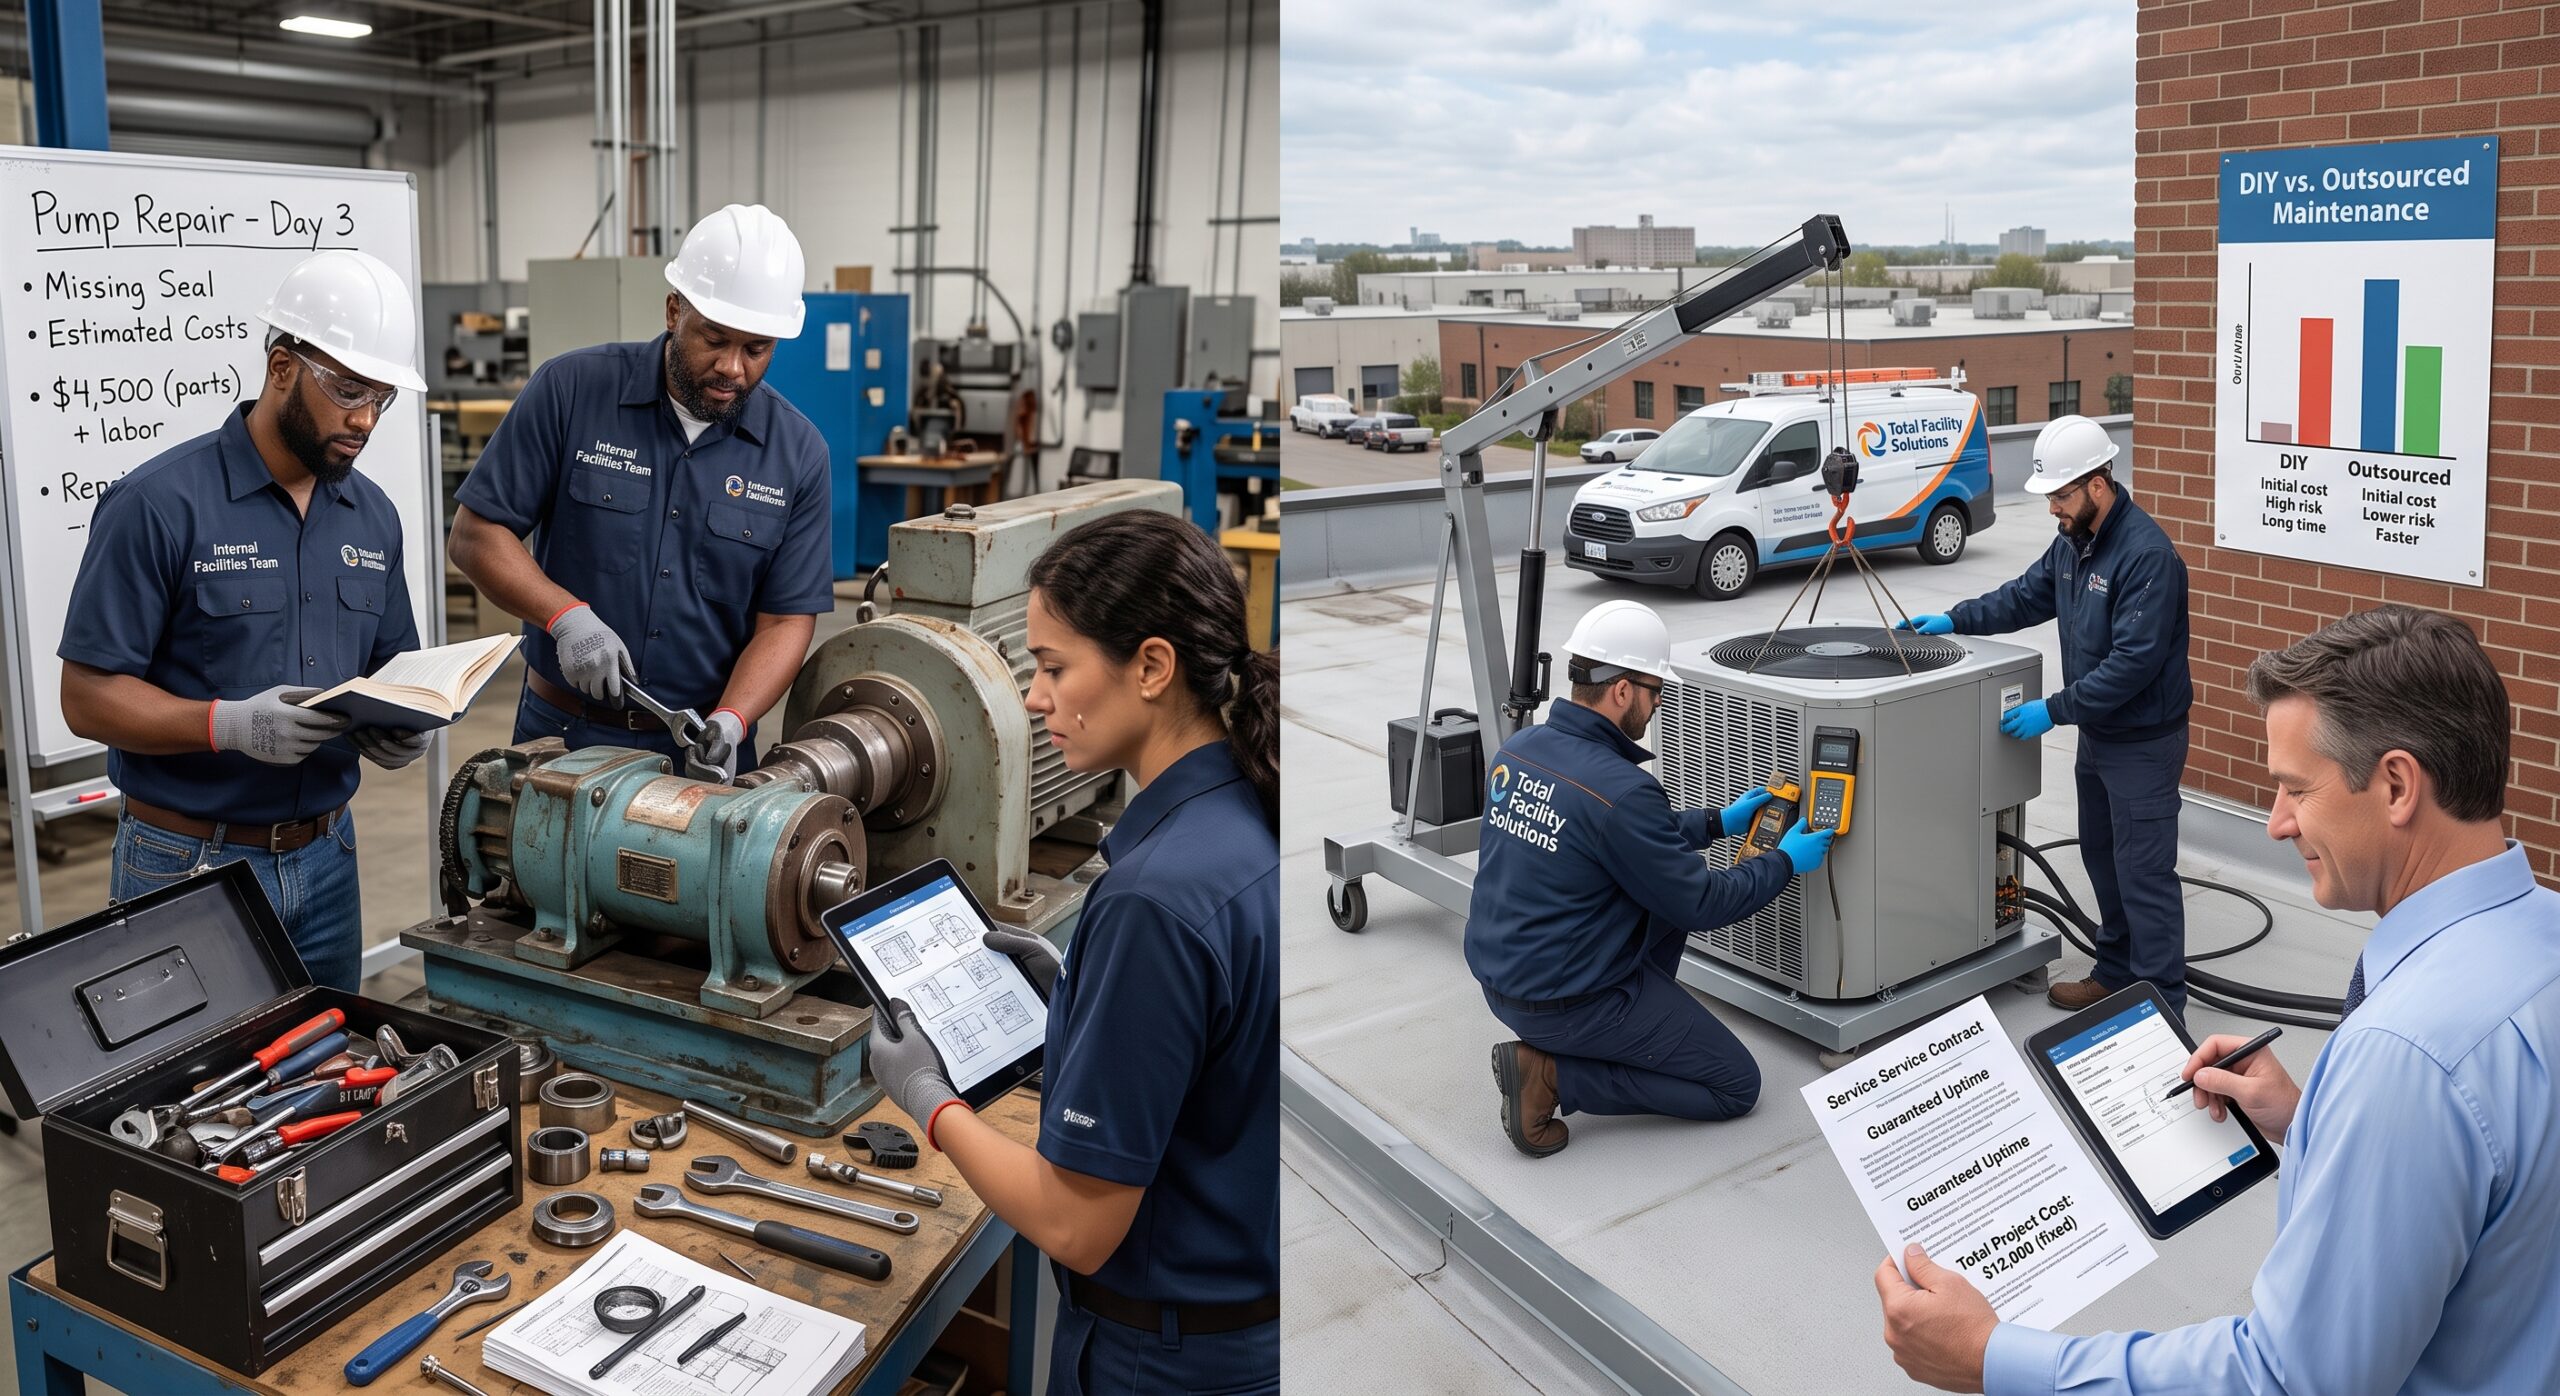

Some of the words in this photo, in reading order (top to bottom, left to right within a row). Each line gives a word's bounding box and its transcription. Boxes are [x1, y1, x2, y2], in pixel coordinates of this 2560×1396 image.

[2240, 171, 2279, 195] DIY
[2284, 173, 2315, 193] vs.
[2322, 160, 2470, 192] Outsourced
[32, 191, 119, 248] Pump
[135, 194, 235, 247] Repair
[270, 200, 323, 251] Day
[336, 203, 354, 236] 3
[2273, 200, 2430, 225] Maintenance
[46, 270, 145, 310] Missing
[159, 270, 214, 298] Seal
[49, 316, 172, 348] Estimated
[184, 314, 248, 341] Costs
[53, 375, 153, 412] $4,500
[164, 364, 242, 407] (parts)
[74, 426, 89, 444] +
[101, 417, 164, 444] labor
[1888, 419, 1919, 435] Total
[1921, 417, 1963, 433] Facility
[595, 440, 638, 459] Internal
[1891, 436, 1949, 452] Solutions
[624, 460, 652, 476] Team
[2280, 454, 2309, 471] DIY
[2348, 461, 2451, 486] Outsourced
[747, 481, 784, 497] Internal
[2261, 477, 2297, 493] Initial
[2301, 482, 2328, 496] cost
[2362, 488, 2403, 505] Initial
[2406, 495, 2437, 509] cost
[2266, 496, 2295, 513] High
[2299, 499, 2323, 514] risk
[2362, 507, 2405, 525] Lower
[2408, 512, 2435, 528] risk
[2262, 514, 2293, 532] Long
[2297, 518, 2327, 534] time
[2375, 528, 2419, 545] Faster
[213, 541, 258, 556] Internal
[249, 557, 279, 569] Team
[1517, 771, 1555, 802] Total
[1509, 792, 1566, 834] Facility
[1489, 806, 1558, 852] Solutions
[1827, 1074, 1879, 1110] Service
[1878, 1051, 1928, 1084] Service
[1928, 1020, 1984, 1057] Contract
[1867, 1091, 1943, 1140] Guaranteed
[1943, 1069, 1990, 1099] Uptime
[1906, 1162, 1983, 1212] Guaranteed
[1982, 1136, 2030, 1167] Uptime
[1955, 1242, 1991, 1272] Total
[1992, 1214, 2040, 1252] Project
[2038, 1193, 2075, 1225] Cost:
[1982, 1241, 2034, 1281] $12,000
[2035, 1214, 2079, 1251] (fixed)
